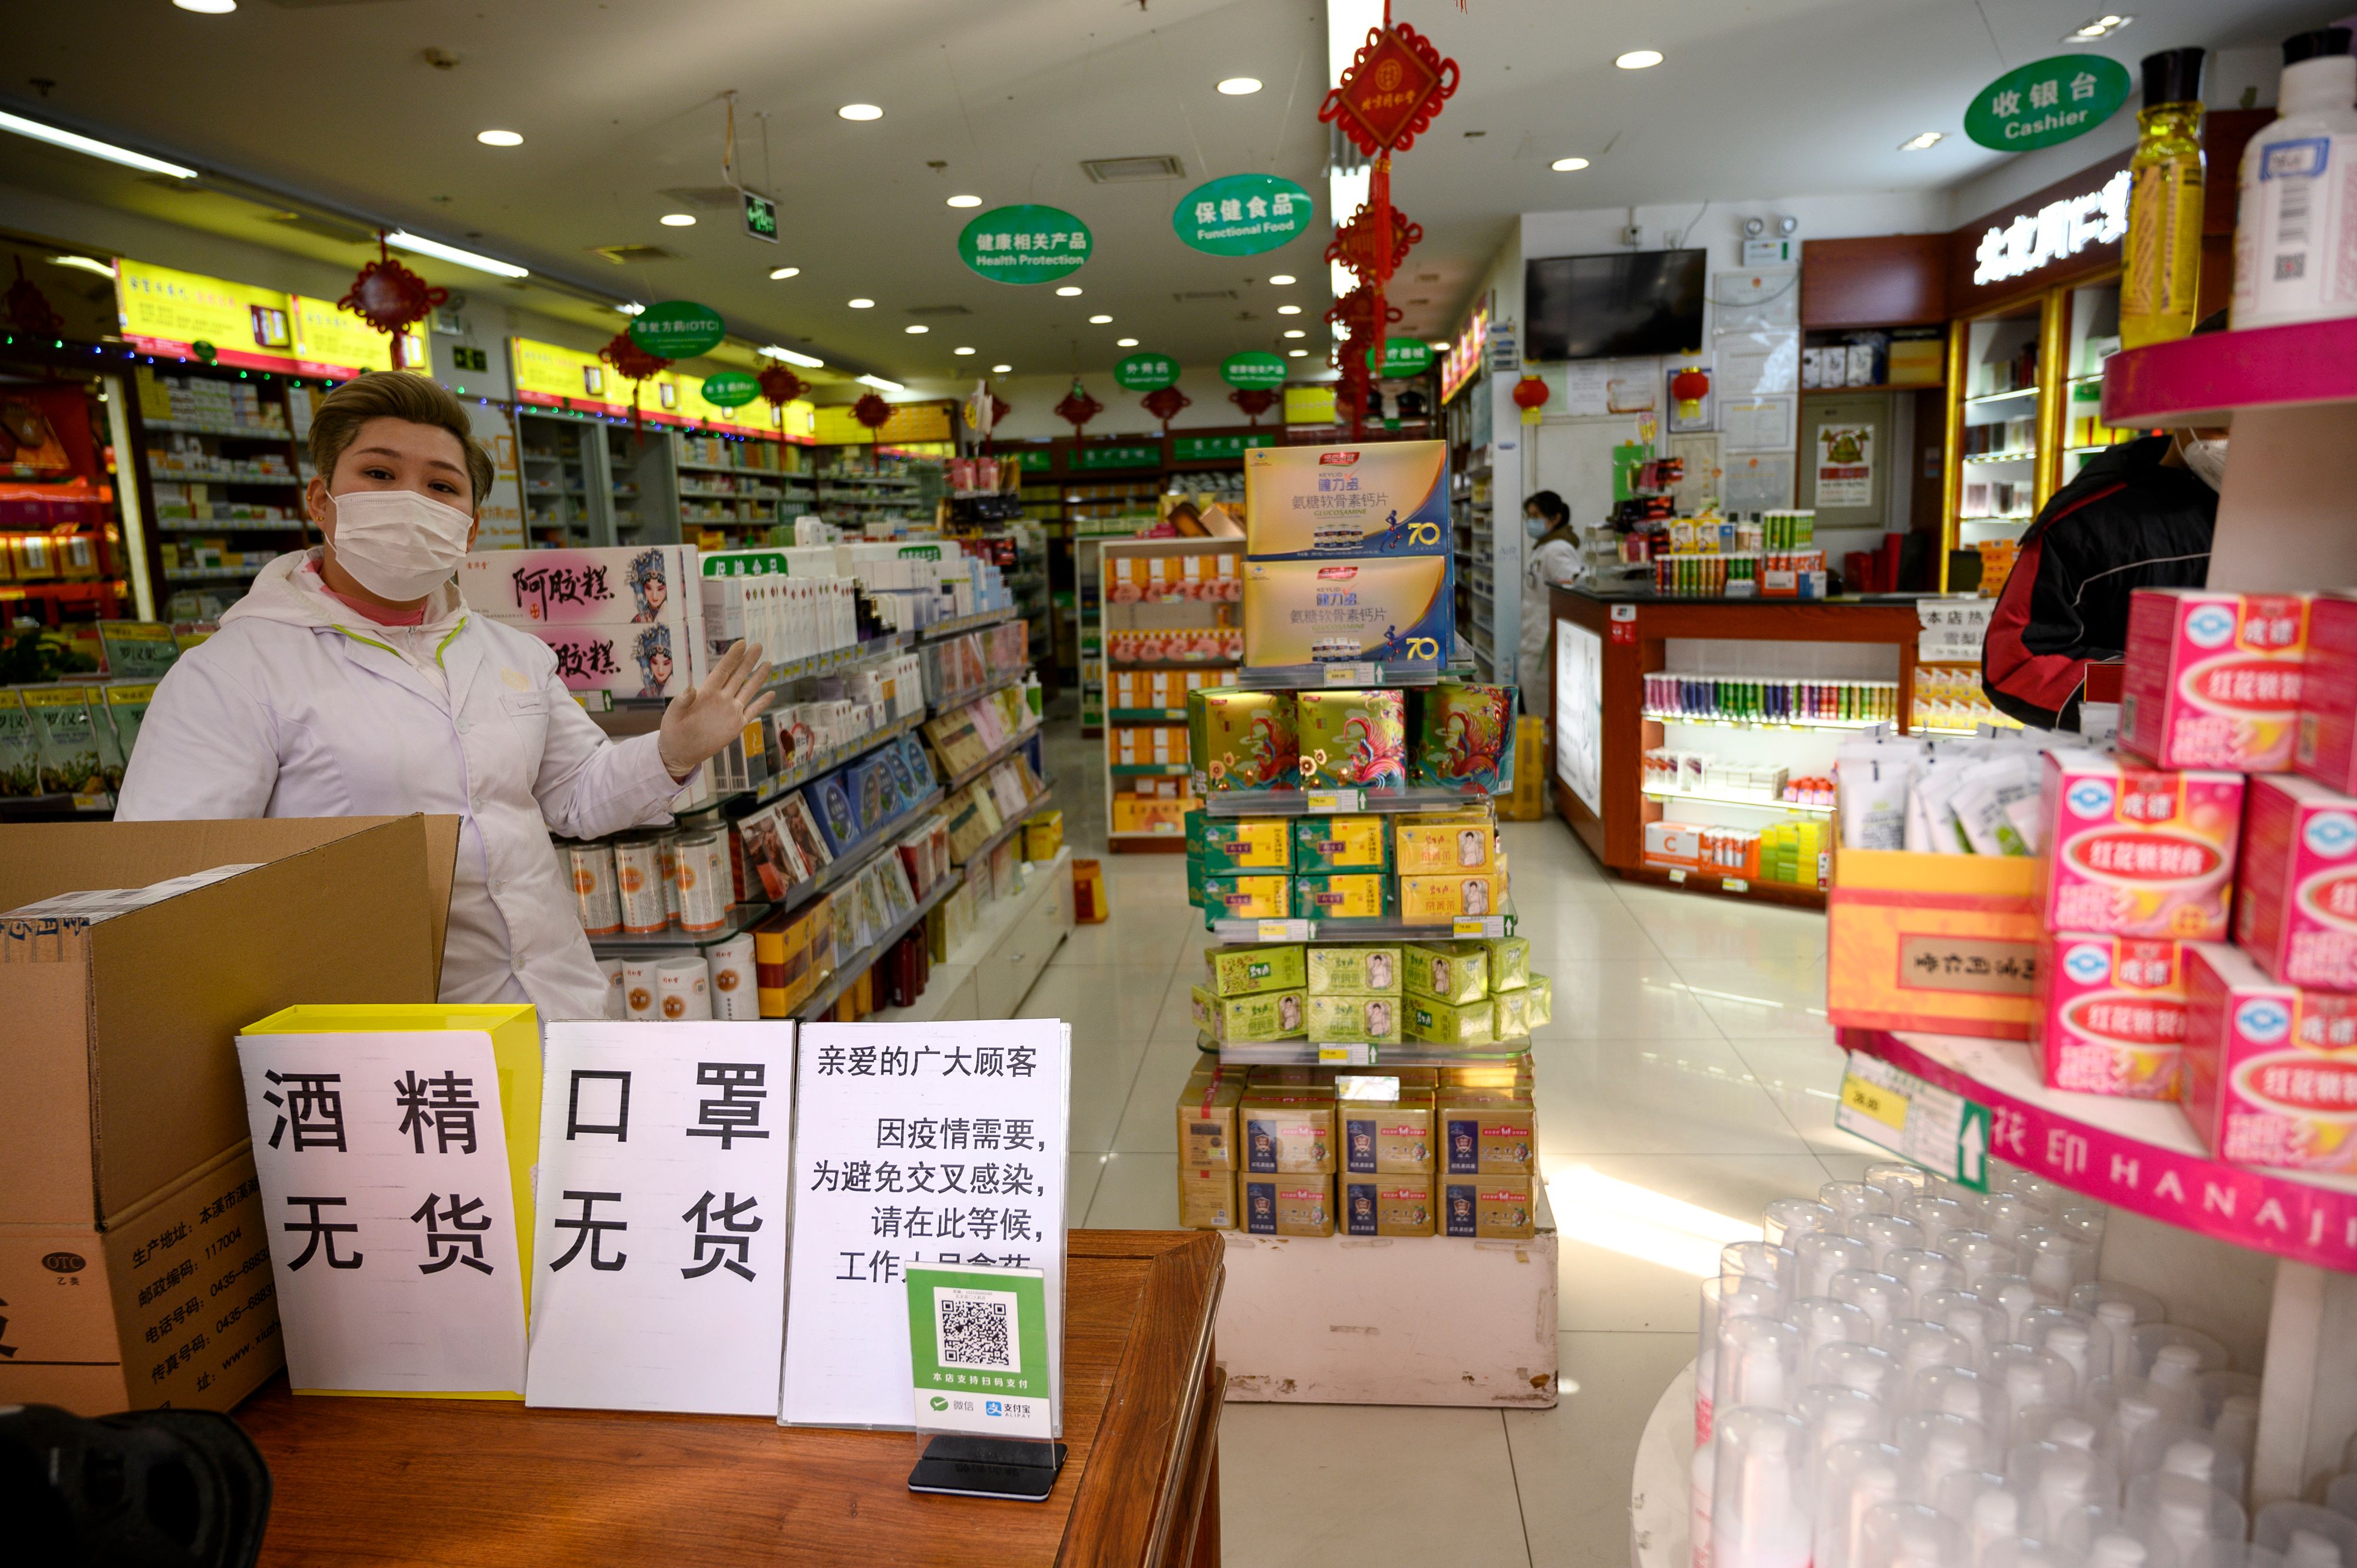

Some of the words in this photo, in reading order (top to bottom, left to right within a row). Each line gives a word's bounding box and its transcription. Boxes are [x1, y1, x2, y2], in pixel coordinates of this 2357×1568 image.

[1992, 71, 2097, 118] 收银台
[2005, 110, 2088, 139] Cashier
[1195, 193, 1293, 225] 保健食品
[976, 232, 1087, 252] 健康相关产品
[1197, 223, 1262, 240] Functional
[1263, 219, 1295, 233] Food
[976, 255, 1017, 266] Health
[1018, 253, 1085, 266] Protection
[1292, 492, 1389, 510] 氨糖软骨素钙片
[1313, 509, 1368, 517] GLUCOSAMINE
[1408, 522, 1441, 547] 70
[512, 565, 616, 622] 阿胶糕
[1290, 607, 1387, 625] 氨糖软骨素钙片
[1406, 637, 1439, 661] 70
[817, 1044, 1038, 1078] 亲爱的广大顾客
[263, 1069, 480, 1154] 酒精
[566, 1062, 770, 1150] 口罩
[876, 1117, 1045, 1152] 因疫情需要，
[810, 1159, 1045, 1197] 为避免交叉感染，
[284, 1192, 494, 1276] 无货
[549, 1190, 763, 1282] 无货
[871, 1205, 1042, 1242] 请在此等候，
[133, 1221, 193, 1269] 生产地址：
[46, 1256, 81, 1270] OTC
[138, 1259, 199, 1309] 邮政编码：
[205, 1226, 242, 1259] 117004
[57, 1276, 81, 1286] 乙类
[145, 1297, 204, 1345] 电话号码：
[151, 1334, 210, 1385] 传真号码：
[933, 1372, 1028, 1389] 本店支持扫码支付
[953, 1400, 974, 1411] 微信
[1003, 1403, 1031, 1414] 支付宝
